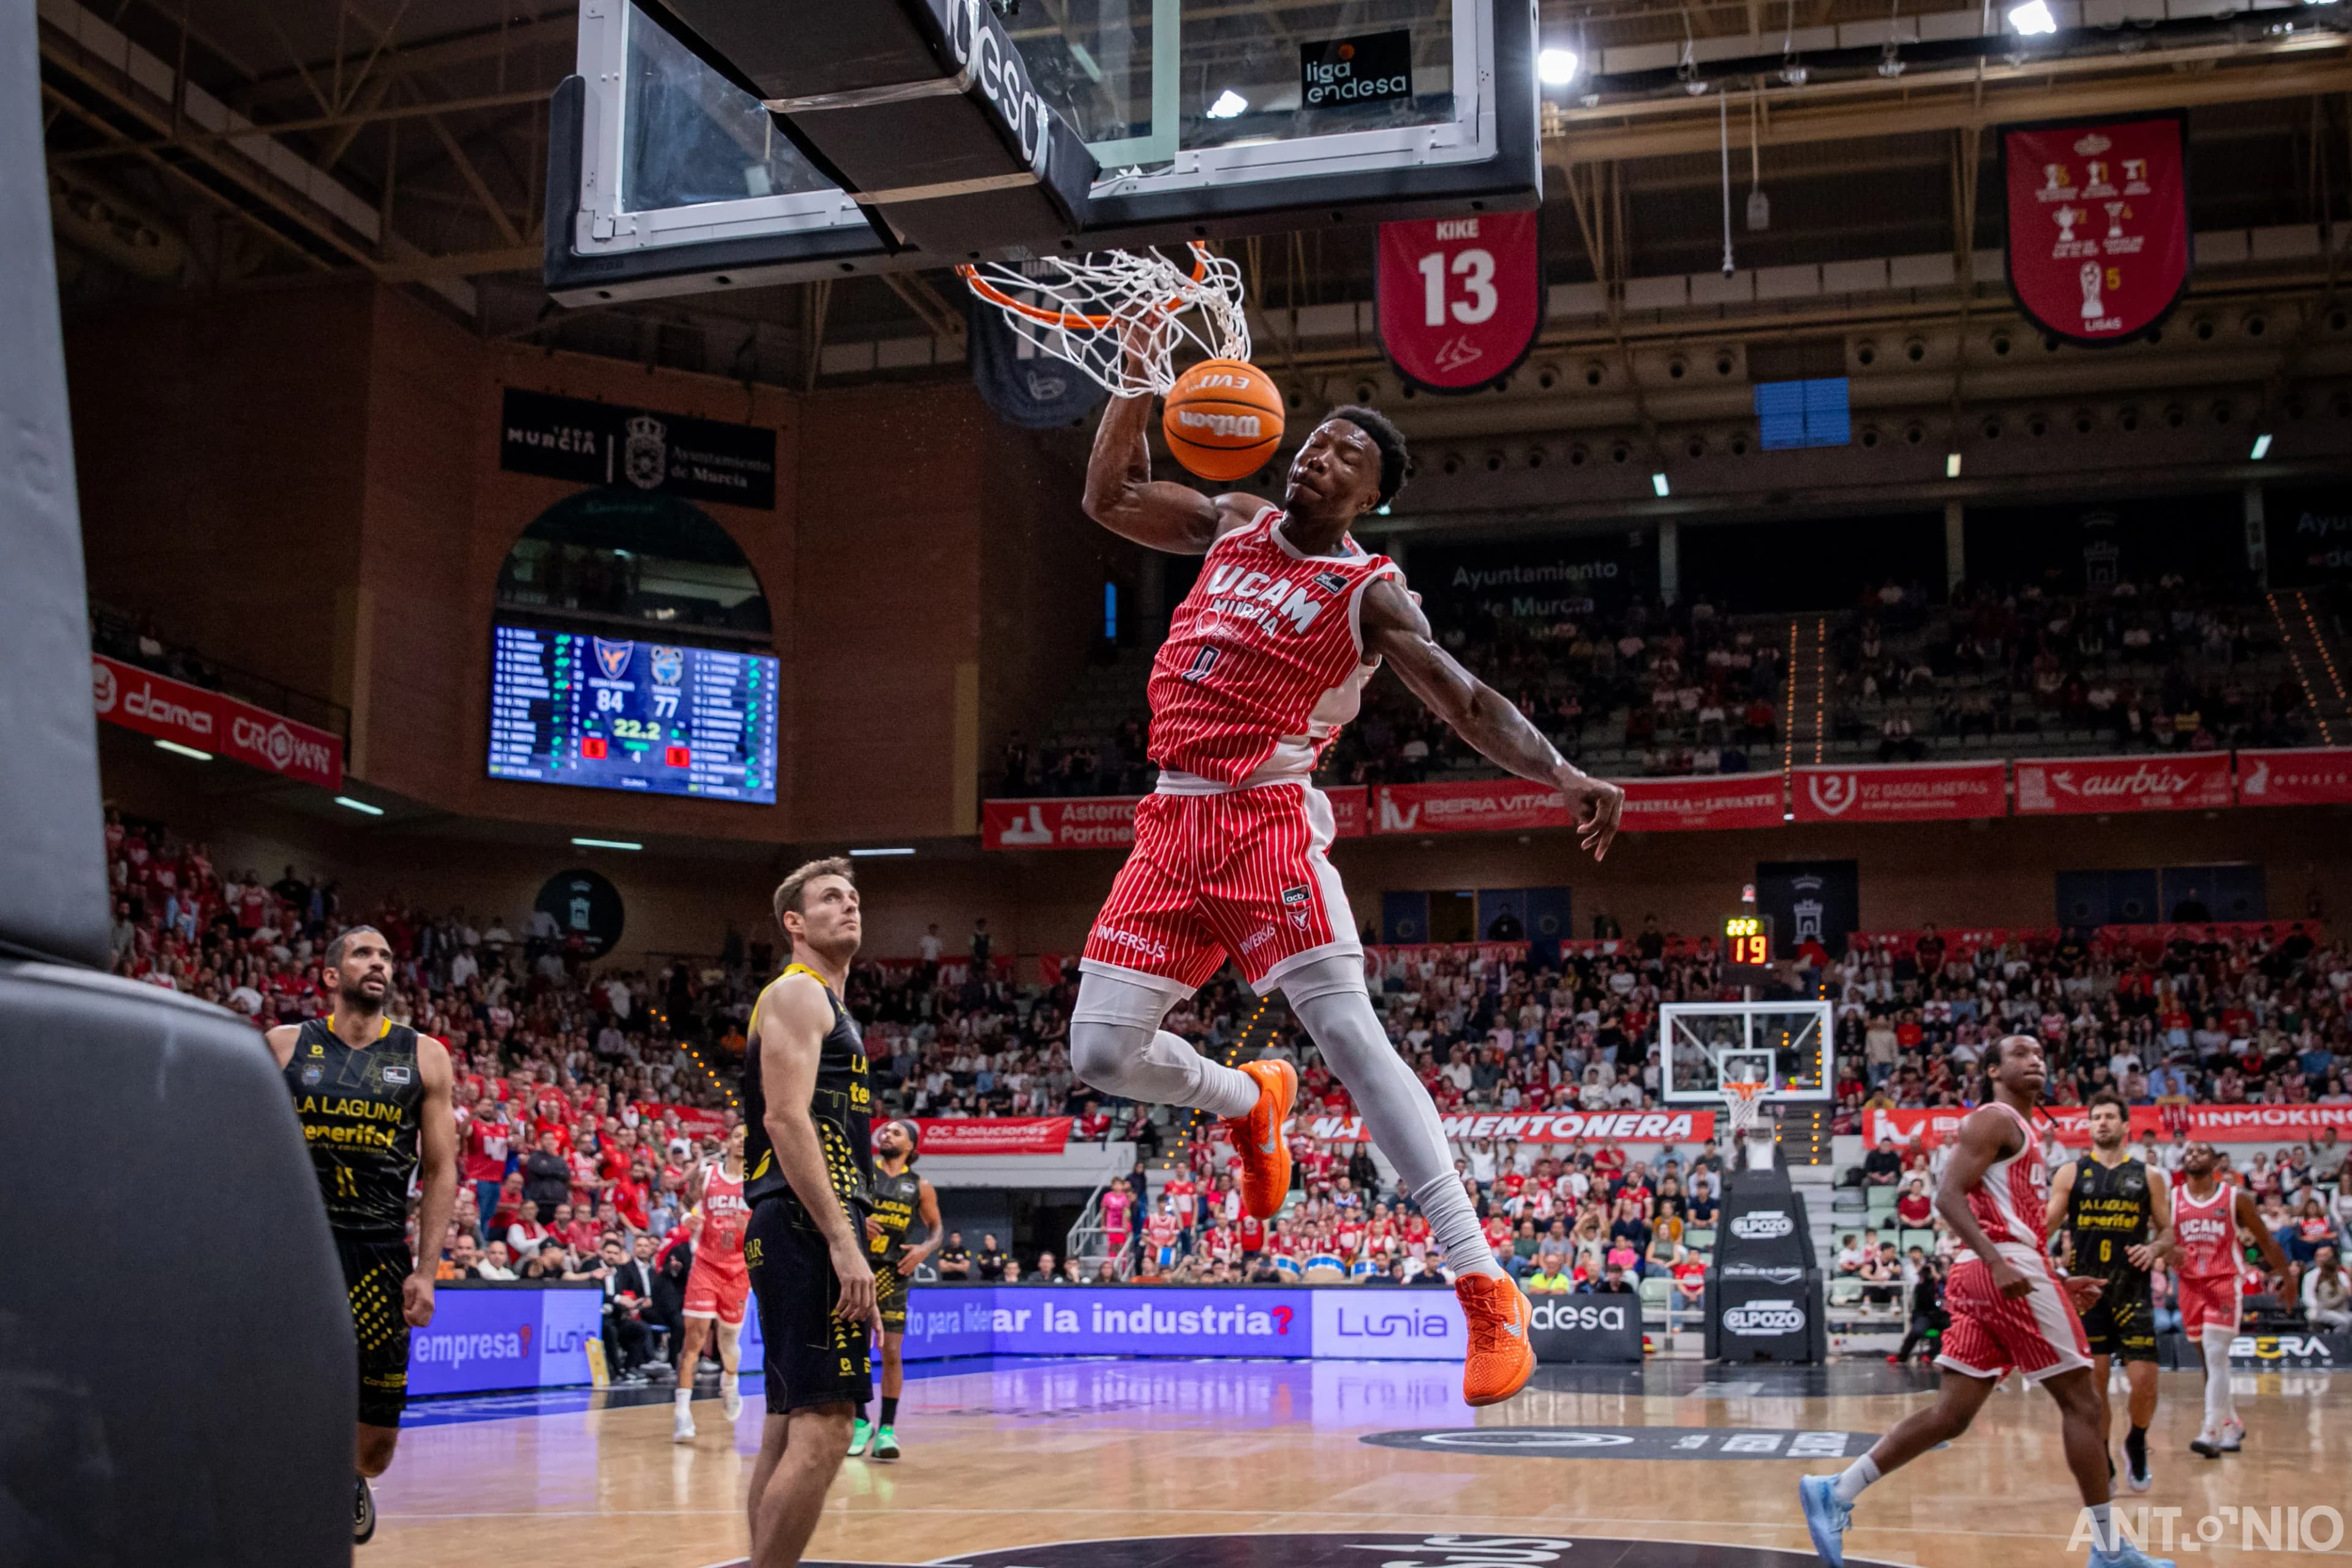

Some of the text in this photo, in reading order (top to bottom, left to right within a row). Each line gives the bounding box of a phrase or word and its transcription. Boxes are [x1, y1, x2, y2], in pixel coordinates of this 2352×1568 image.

[1306, 61, 1351, 84] liga
[1307, 75, 1406, 104] endesa
[1436, 218, 1479, 240] KIKE
[1418, 248, 1499, 326] 13
[2106, 267, 2121, 291] 5
[2085, 317, 2122, 332] LIGAS
[1179, 410, 1261, 438] Wilson
[507, 428, 597, 455] MURCIA
[693, 467, 748, 488] Murcia
[1452, 559, 1619, 590] Ayuntamiento
[1206, 565, 1323, 635] UCAM
[596, 688, 625, 714] 84
[653, 695, 679, 718] 77
[614, 718, 662, 741] 22.2
[232, 715, 331, 775] CROWN
[1425, 797, 1496, 815] IBERIA
[1286, 893, 1305, 902] acb
[1096, 924, 1166, 959] INVERSUS
[1736, 935, 1766, 964] 19
[294, 1096, 402, 1124] LA LAGUNA
[926, 1125, 1048, 1137] OC Soluciones
[2179, 1218, 2226, 1236] UCAM
[2100, 1238, 2111, 1263] 6
[927, 1309, 960, 1343] para
[1043, 1302, 1080, 1333] la
[1091, 1302, 1294, 1336] industria?
[1338, 1307, 1448, 1338] Lunia
[415, 1324, 532, 1370] empresa?
